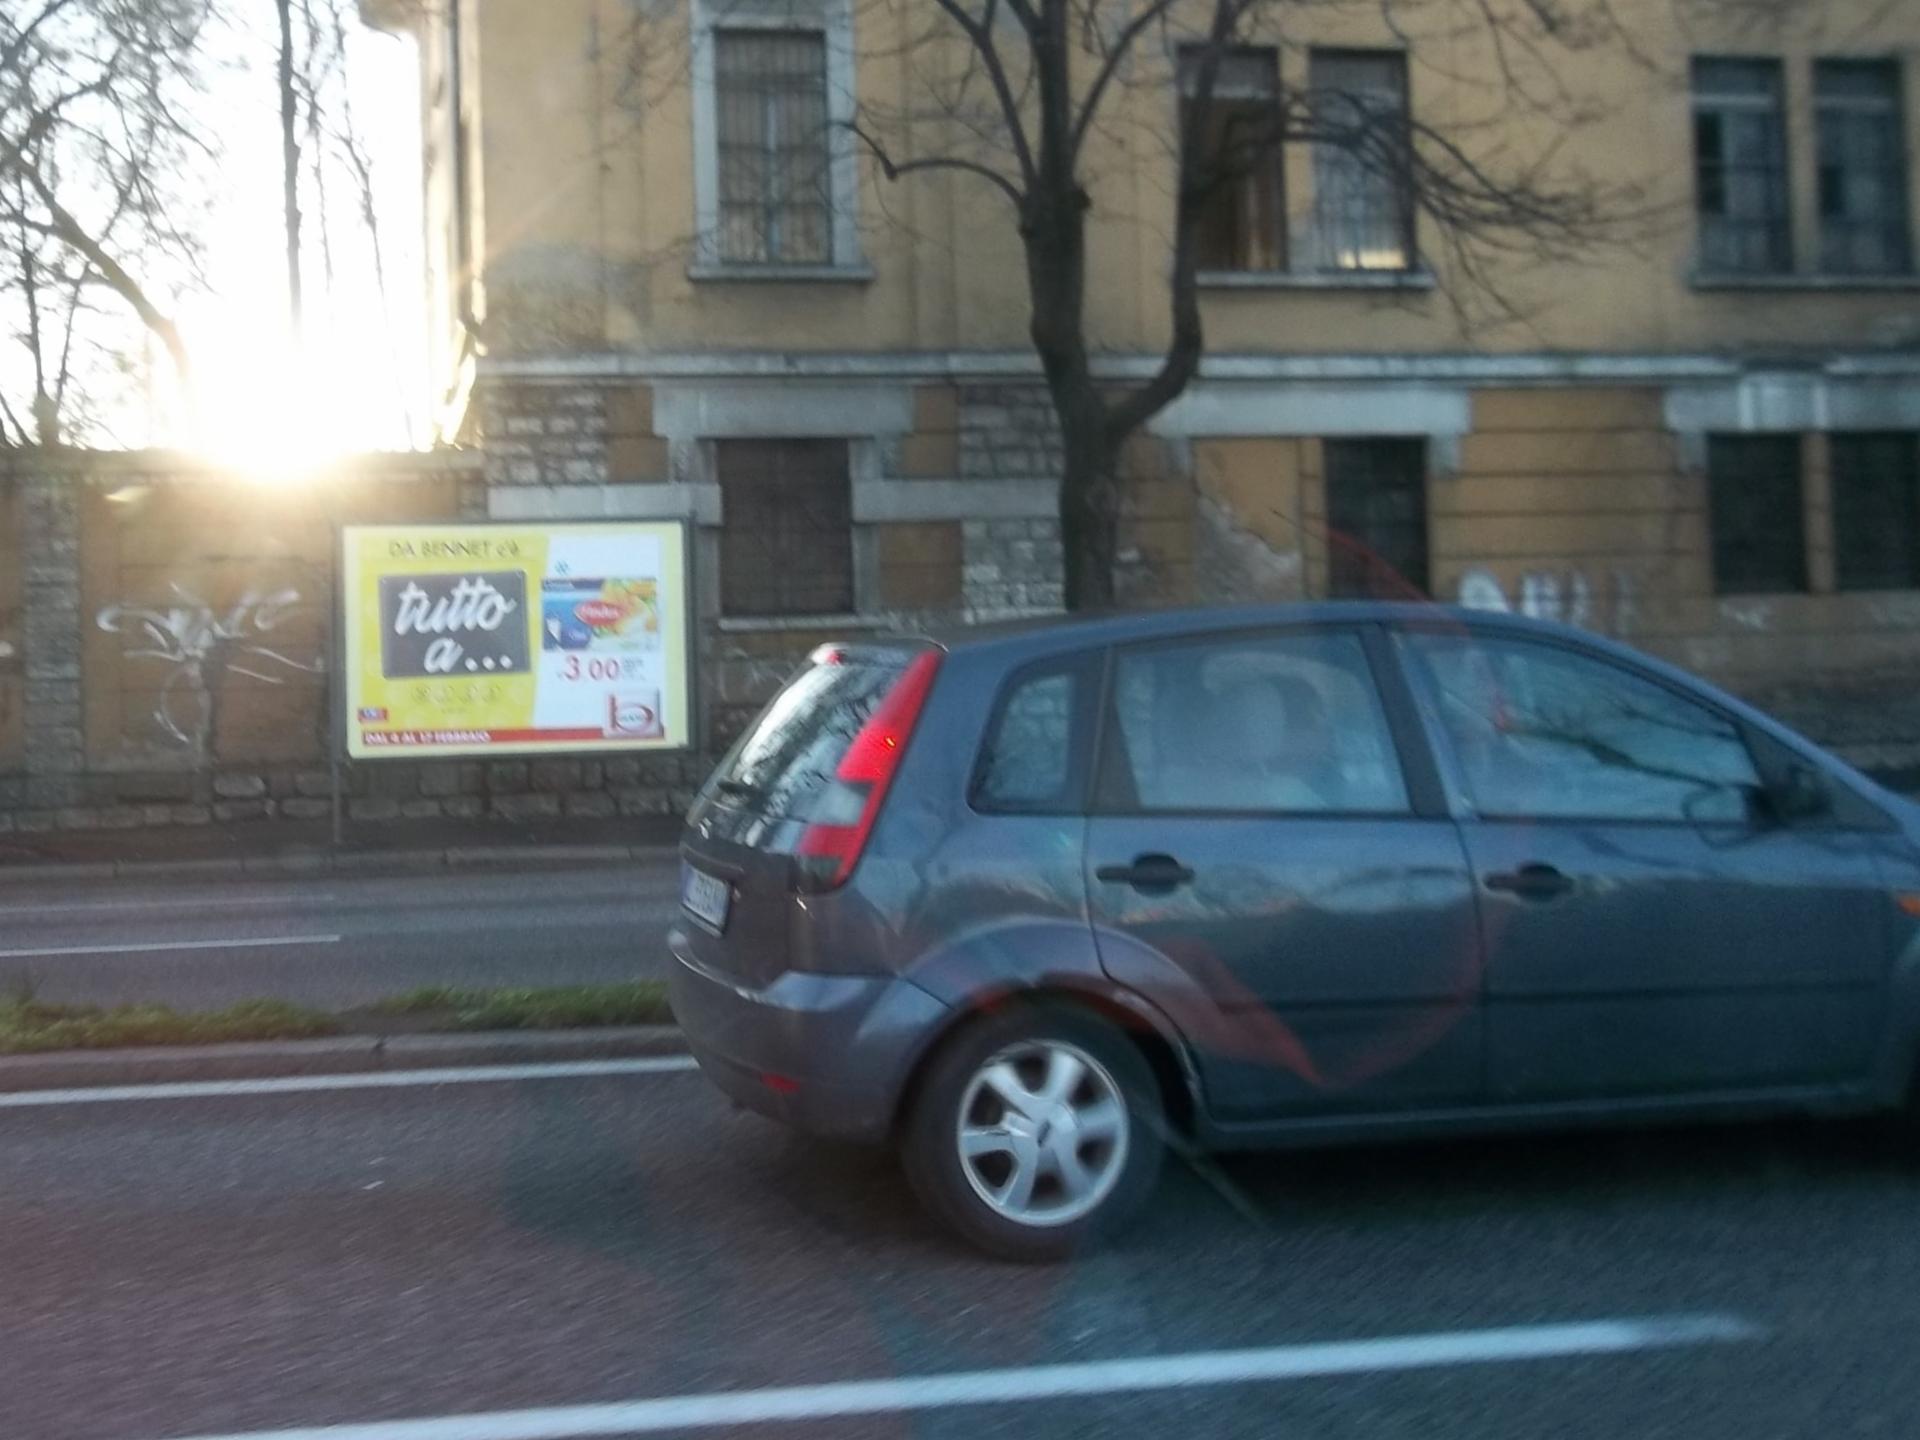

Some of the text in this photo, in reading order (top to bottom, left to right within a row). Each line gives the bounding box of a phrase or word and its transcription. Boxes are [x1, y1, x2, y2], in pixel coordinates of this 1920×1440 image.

[388, 539, 417, 557] DA
[421, 539, 491, 557] BENNET
[394, 578, 517, 635] tutto
[423, 637, 513, 673] a...
